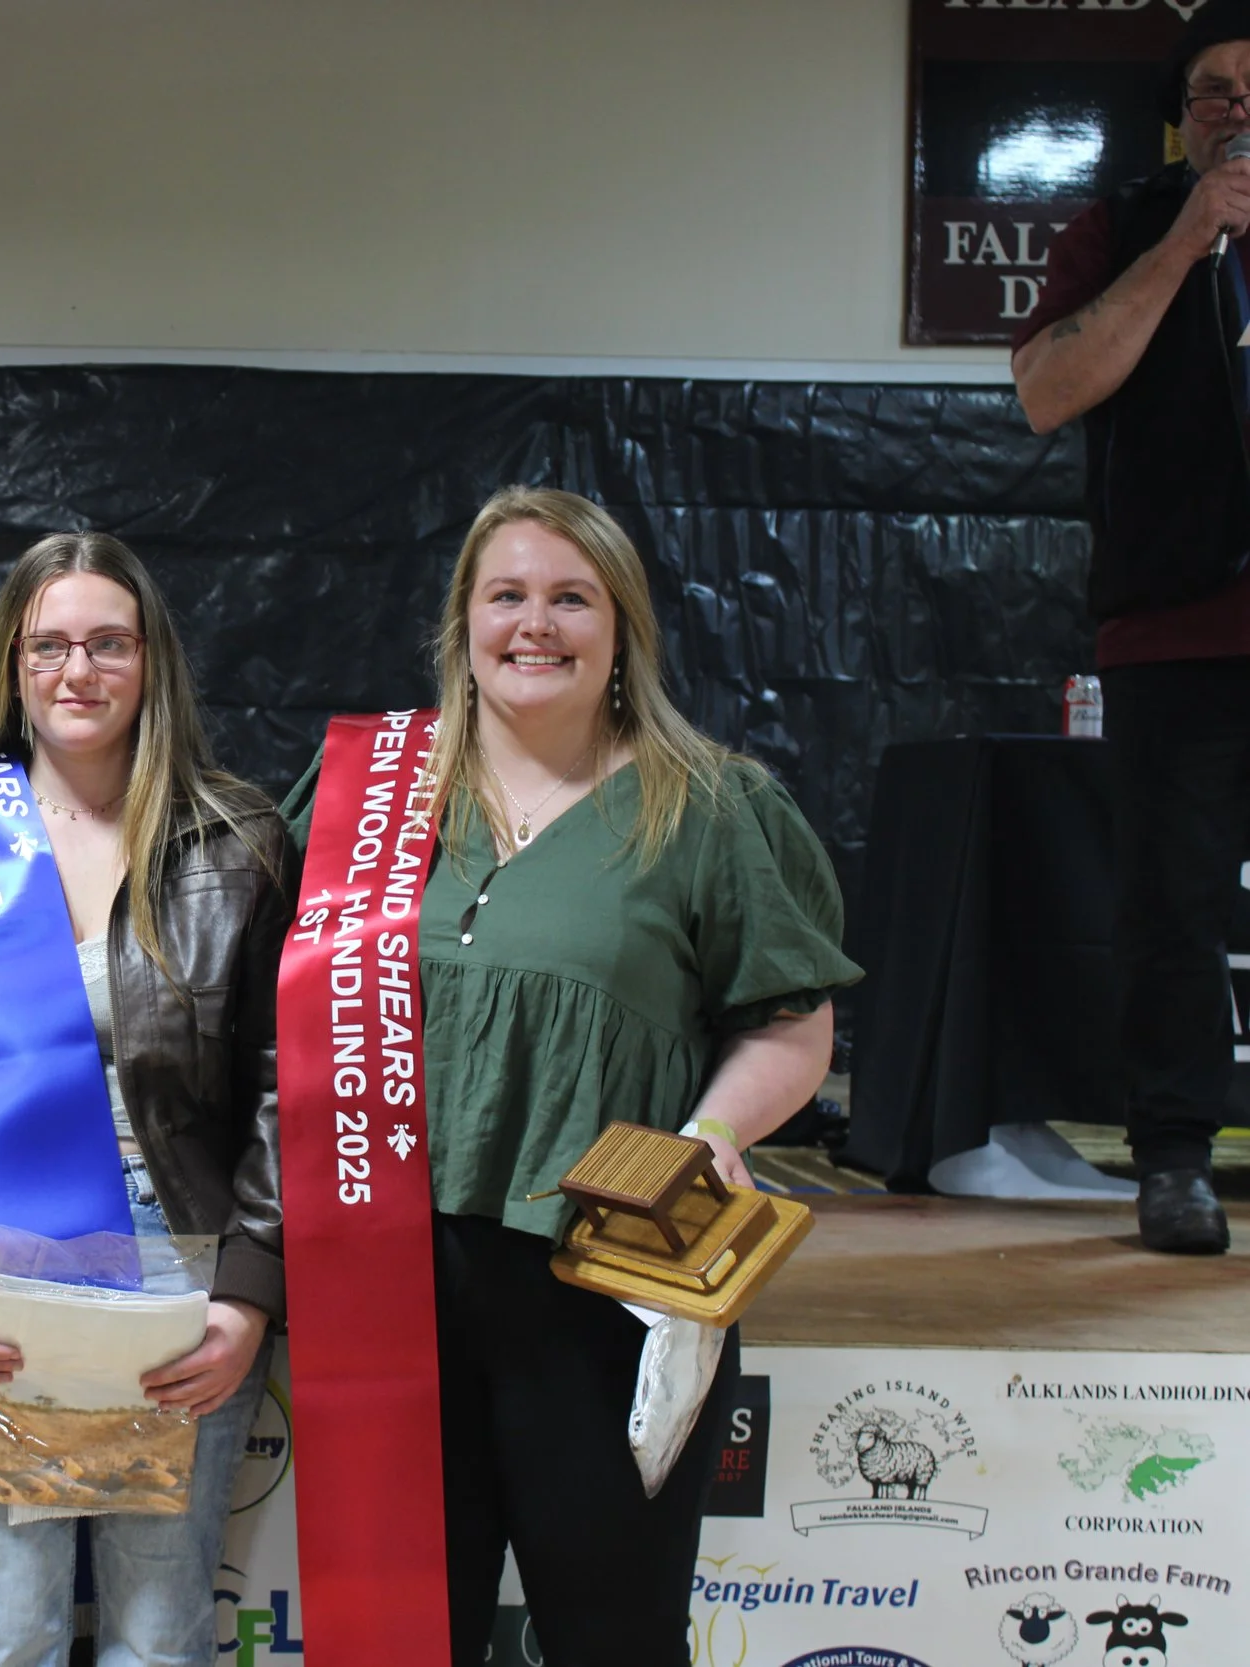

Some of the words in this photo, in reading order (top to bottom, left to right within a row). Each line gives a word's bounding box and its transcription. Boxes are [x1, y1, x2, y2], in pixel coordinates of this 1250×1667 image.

[943, 220, 1068, 267] FAL
[999, 276, 1048, 318] D
[346, 779, 397, 885] WOOL
[293, 888, 334, 946] 1ST
[330, 889, 372, 1098] HANDLING
[377, 931, 417, 1107] SHEARS
[335, 1110, 372, 1205] 2025
[1006, 1382, 1118, 1401] FALKLANDS
[1122, 1384, 1250, 1402] LANDHOLDIN
[808, 1383, 876, 1455] SHEARING
[885, 1380, 951, 1410] ISLAND
[953, 1411, 978, 1459] WIDE
[717, 1448, 751, 1470] RE
[1064, 1514, 1204, 1534] CORPORATION
[822, 1578, 919, 1608] Travel
[964, 1562, 1058, 1590] Rincon
[1063, 1559, 1160, 1584] Grande
[1165, 1564, 1232, 1595] Farm
[796, 1650, 853, 1667] ational
[855, 1651, 895, 1667] Tours
